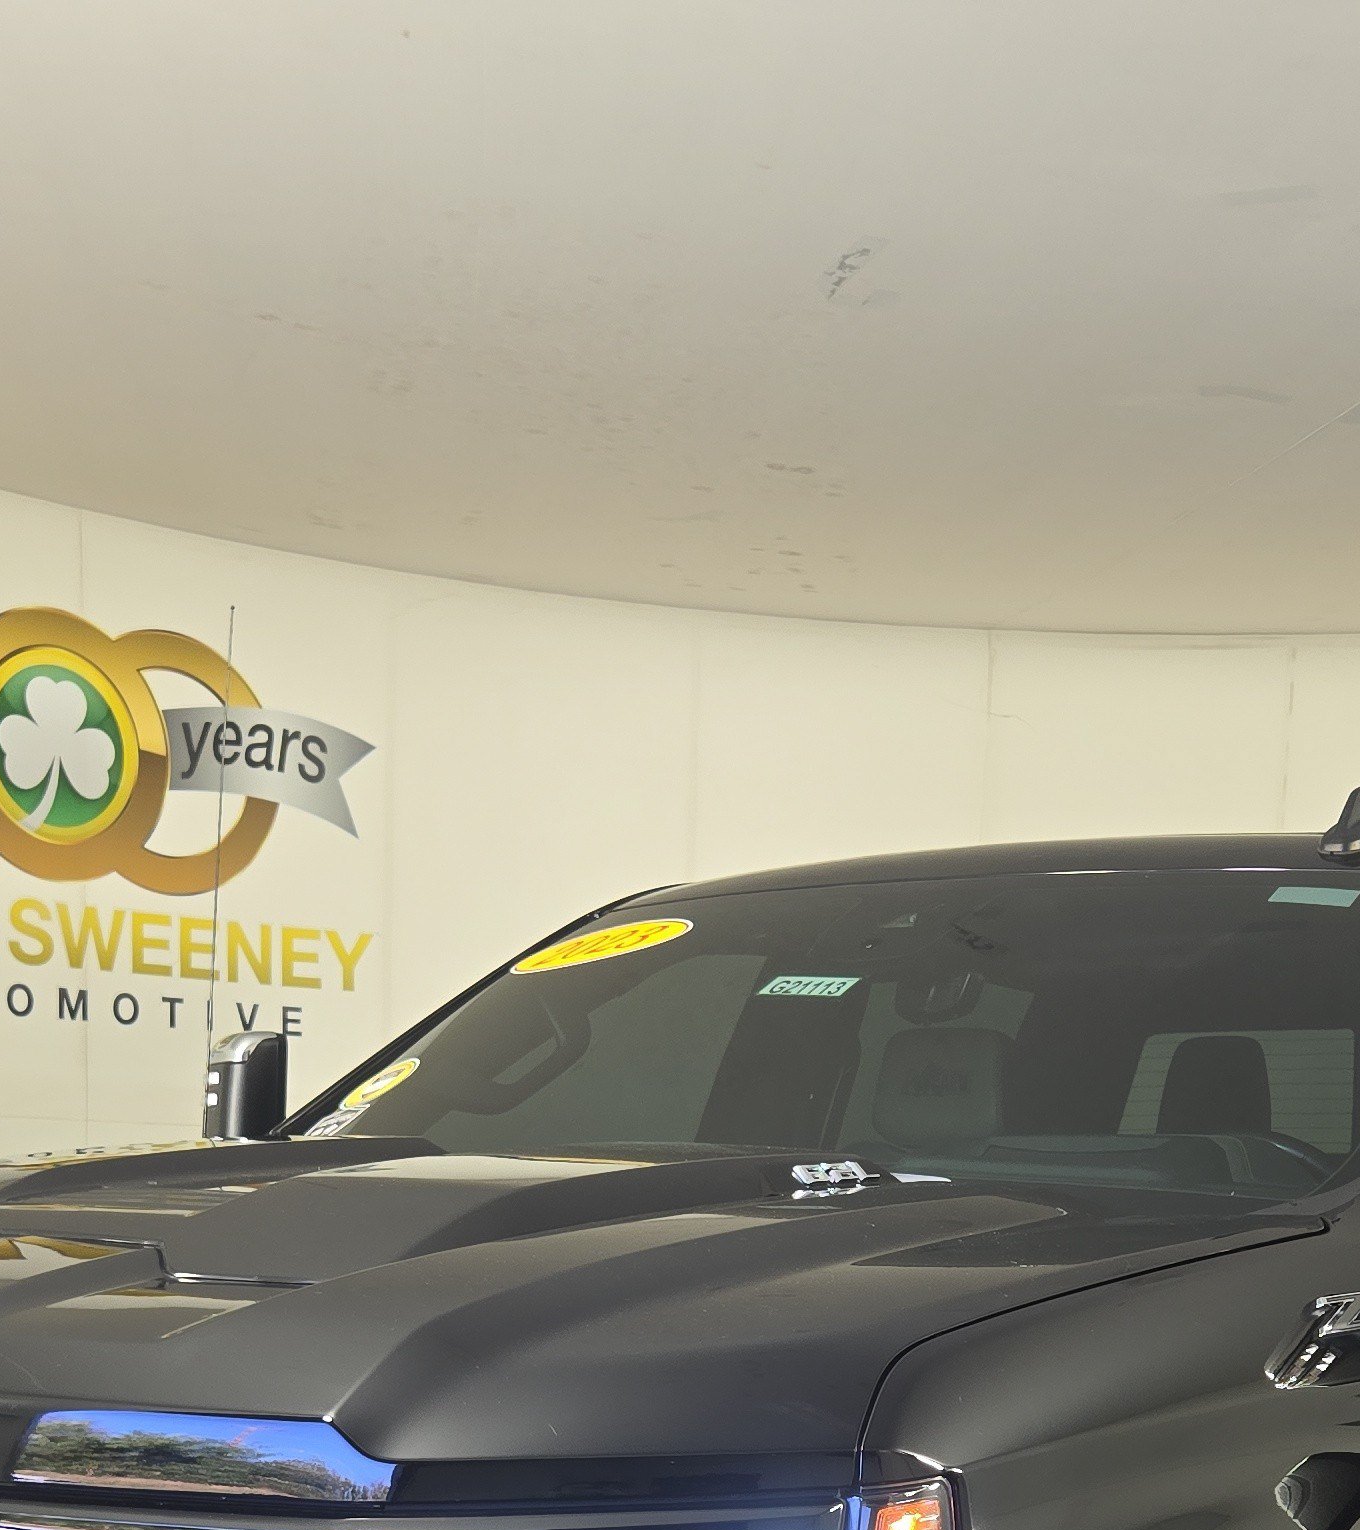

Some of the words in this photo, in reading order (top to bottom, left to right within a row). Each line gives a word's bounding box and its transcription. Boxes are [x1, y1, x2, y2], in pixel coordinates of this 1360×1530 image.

[180, 718, 328, 784] years
[7, 897, 375, 992] SWEENEY
[769, 980, 847, 995] G21113
